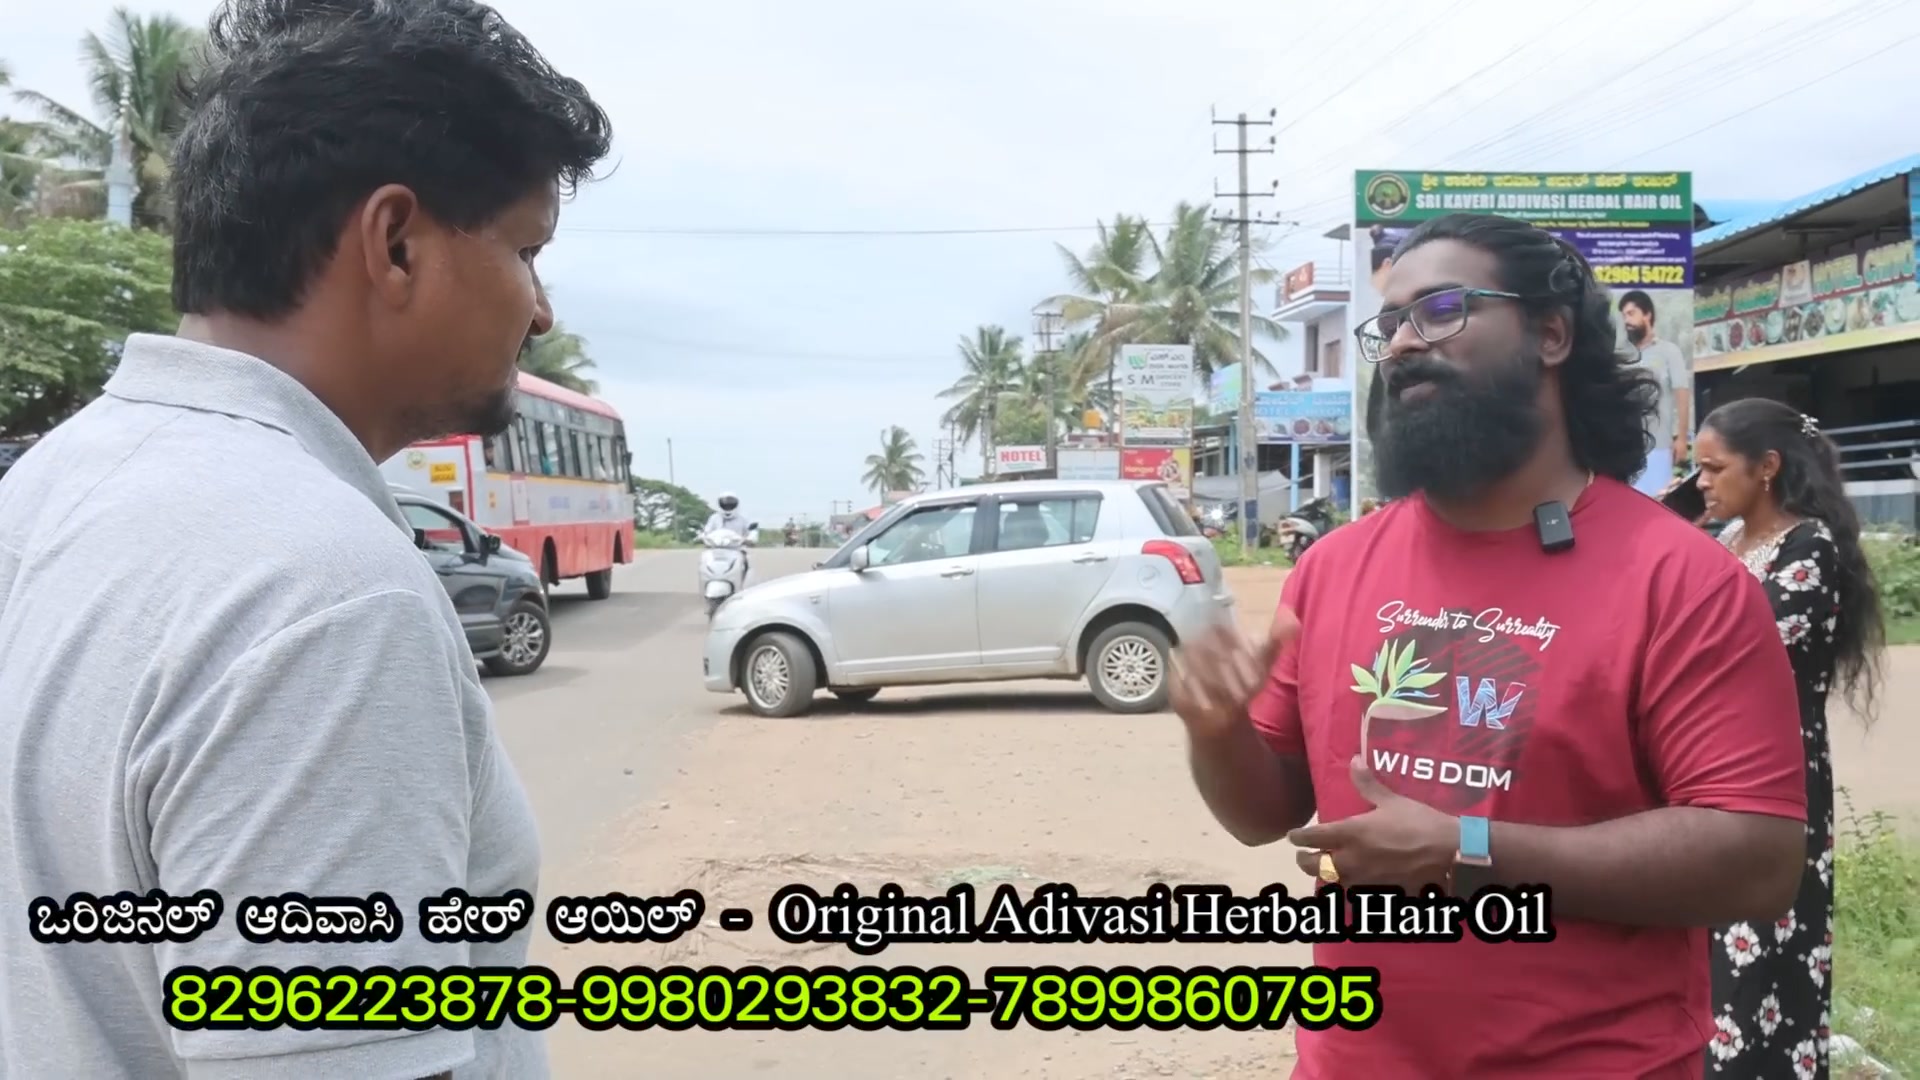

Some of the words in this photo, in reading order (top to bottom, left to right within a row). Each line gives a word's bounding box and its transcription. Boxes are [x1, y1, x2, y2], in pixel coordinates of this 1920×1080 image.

[1415, 193, 1441, 209] SRI
[1443, 193, 1495, 209] KAVERI
[1496, 194, 1566, 209] ADHIVASI
[1568, 194, 1621, 209] HERBAL
[1623, 194, 1657, 209] HAIR
[1659, 194, 1683, 209] OIL
[1641, 265, 1685, 284] 54722
[1127, 374, 1136, 385] S
[1140, 374, 1155, 385] M
[1000, 450, 1043, 463] HOTEL
[1376, 600, 1449, 633] Surrender
[1450, 611, 1473, 629] to
[1473, 607, 1561, 651] Surreality
[1373, 749, 1512, 791] WISDOM
